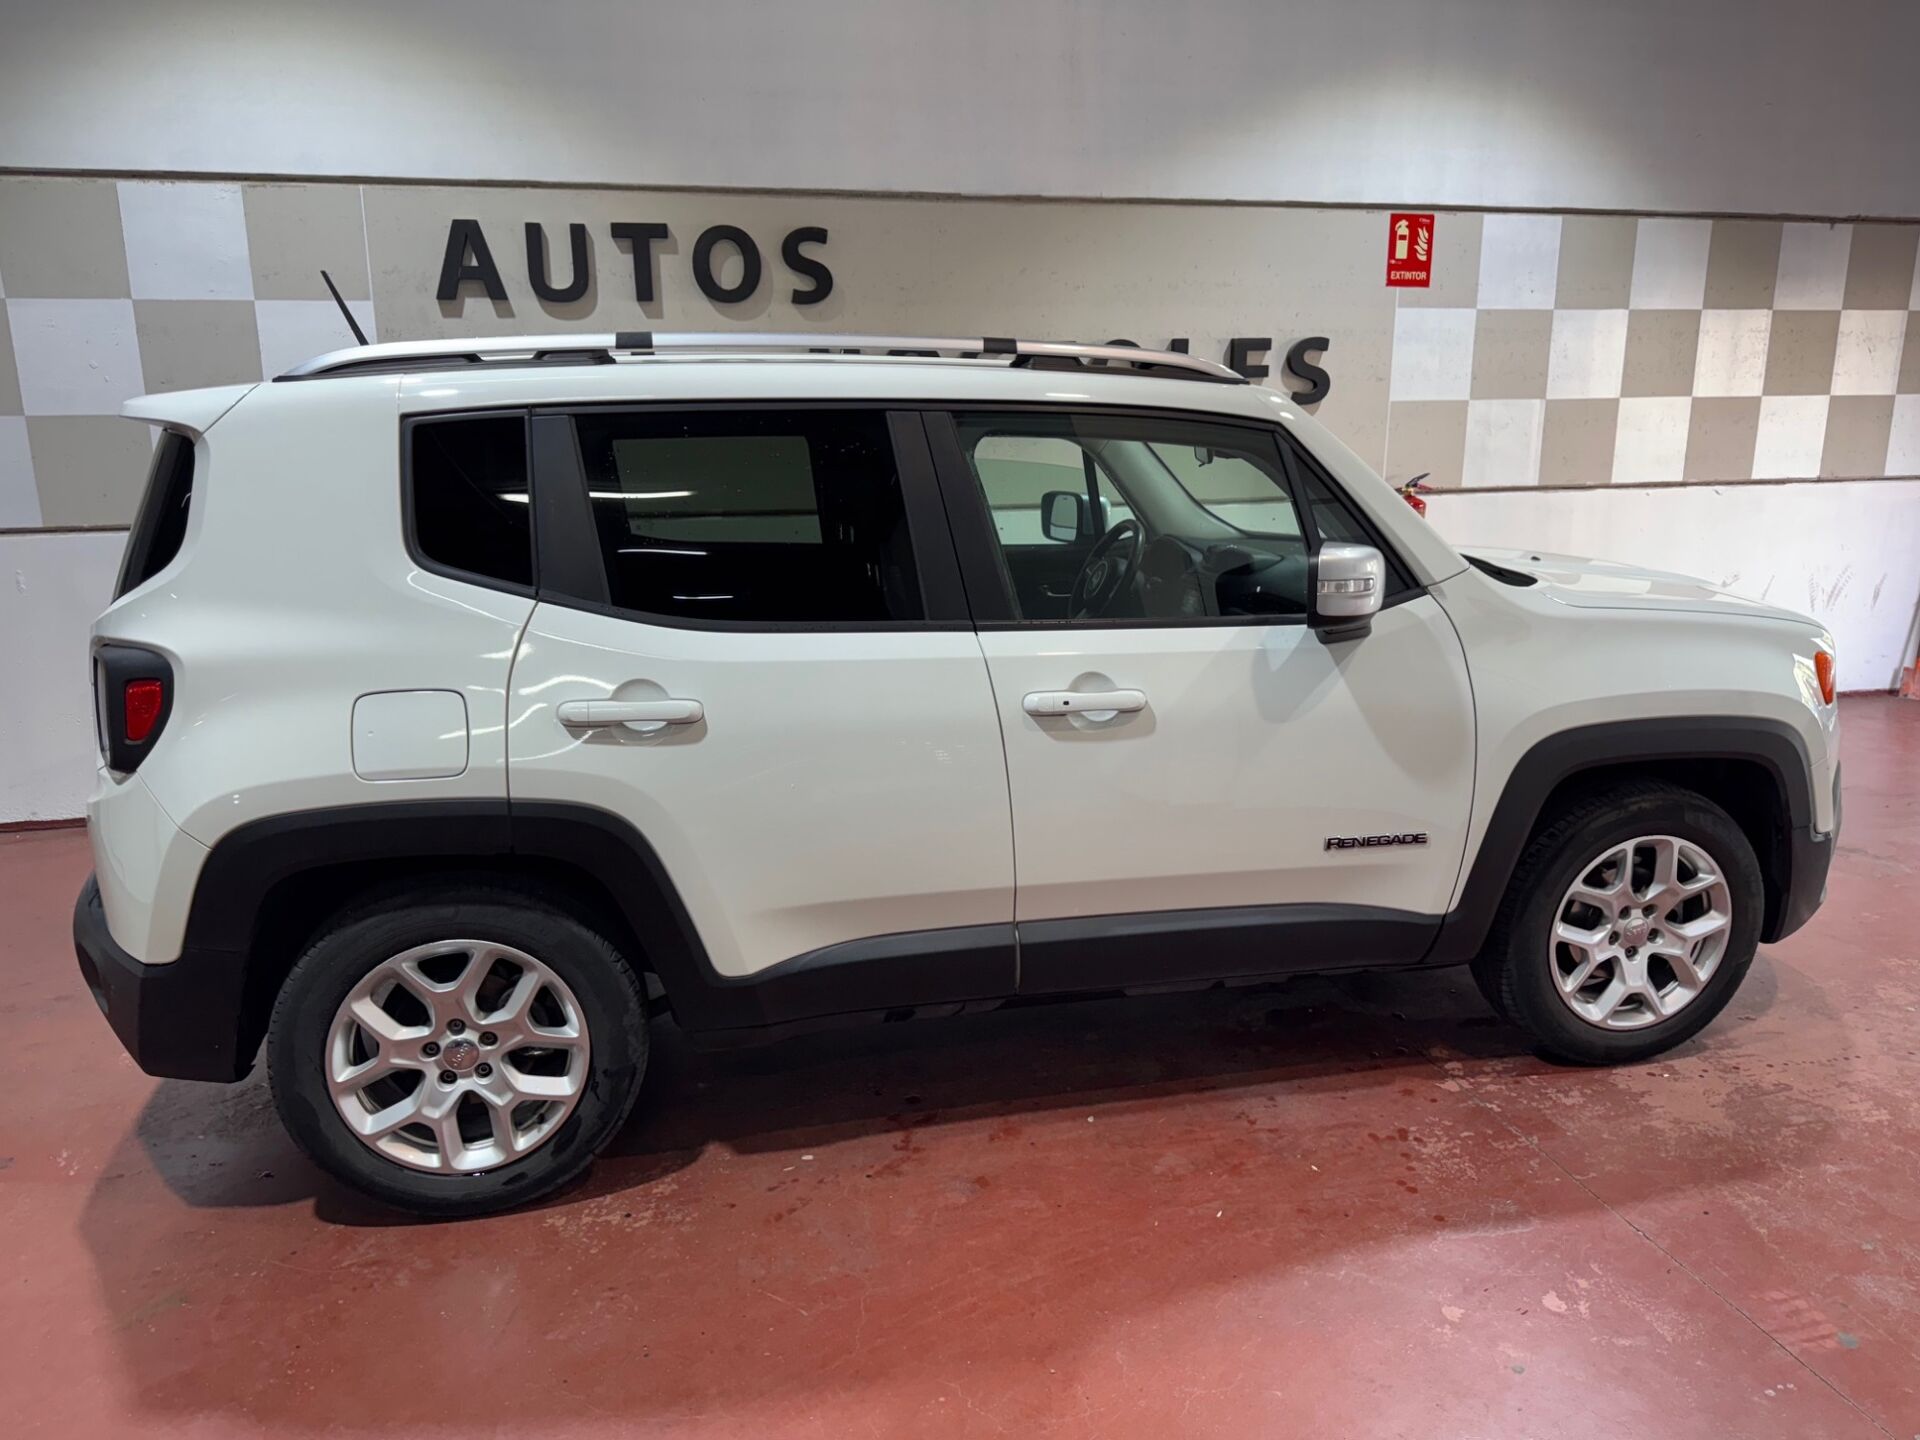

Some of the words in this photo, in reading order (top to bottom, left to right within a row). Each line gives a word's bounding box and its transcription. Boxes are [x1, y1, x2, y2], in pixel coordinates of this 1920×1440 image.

[436, 219, 834, 304] AUTOS
[1390, 270, 1427, 280] EXTINTOR
[1324, 833, 1427, 851] RENEGADE
